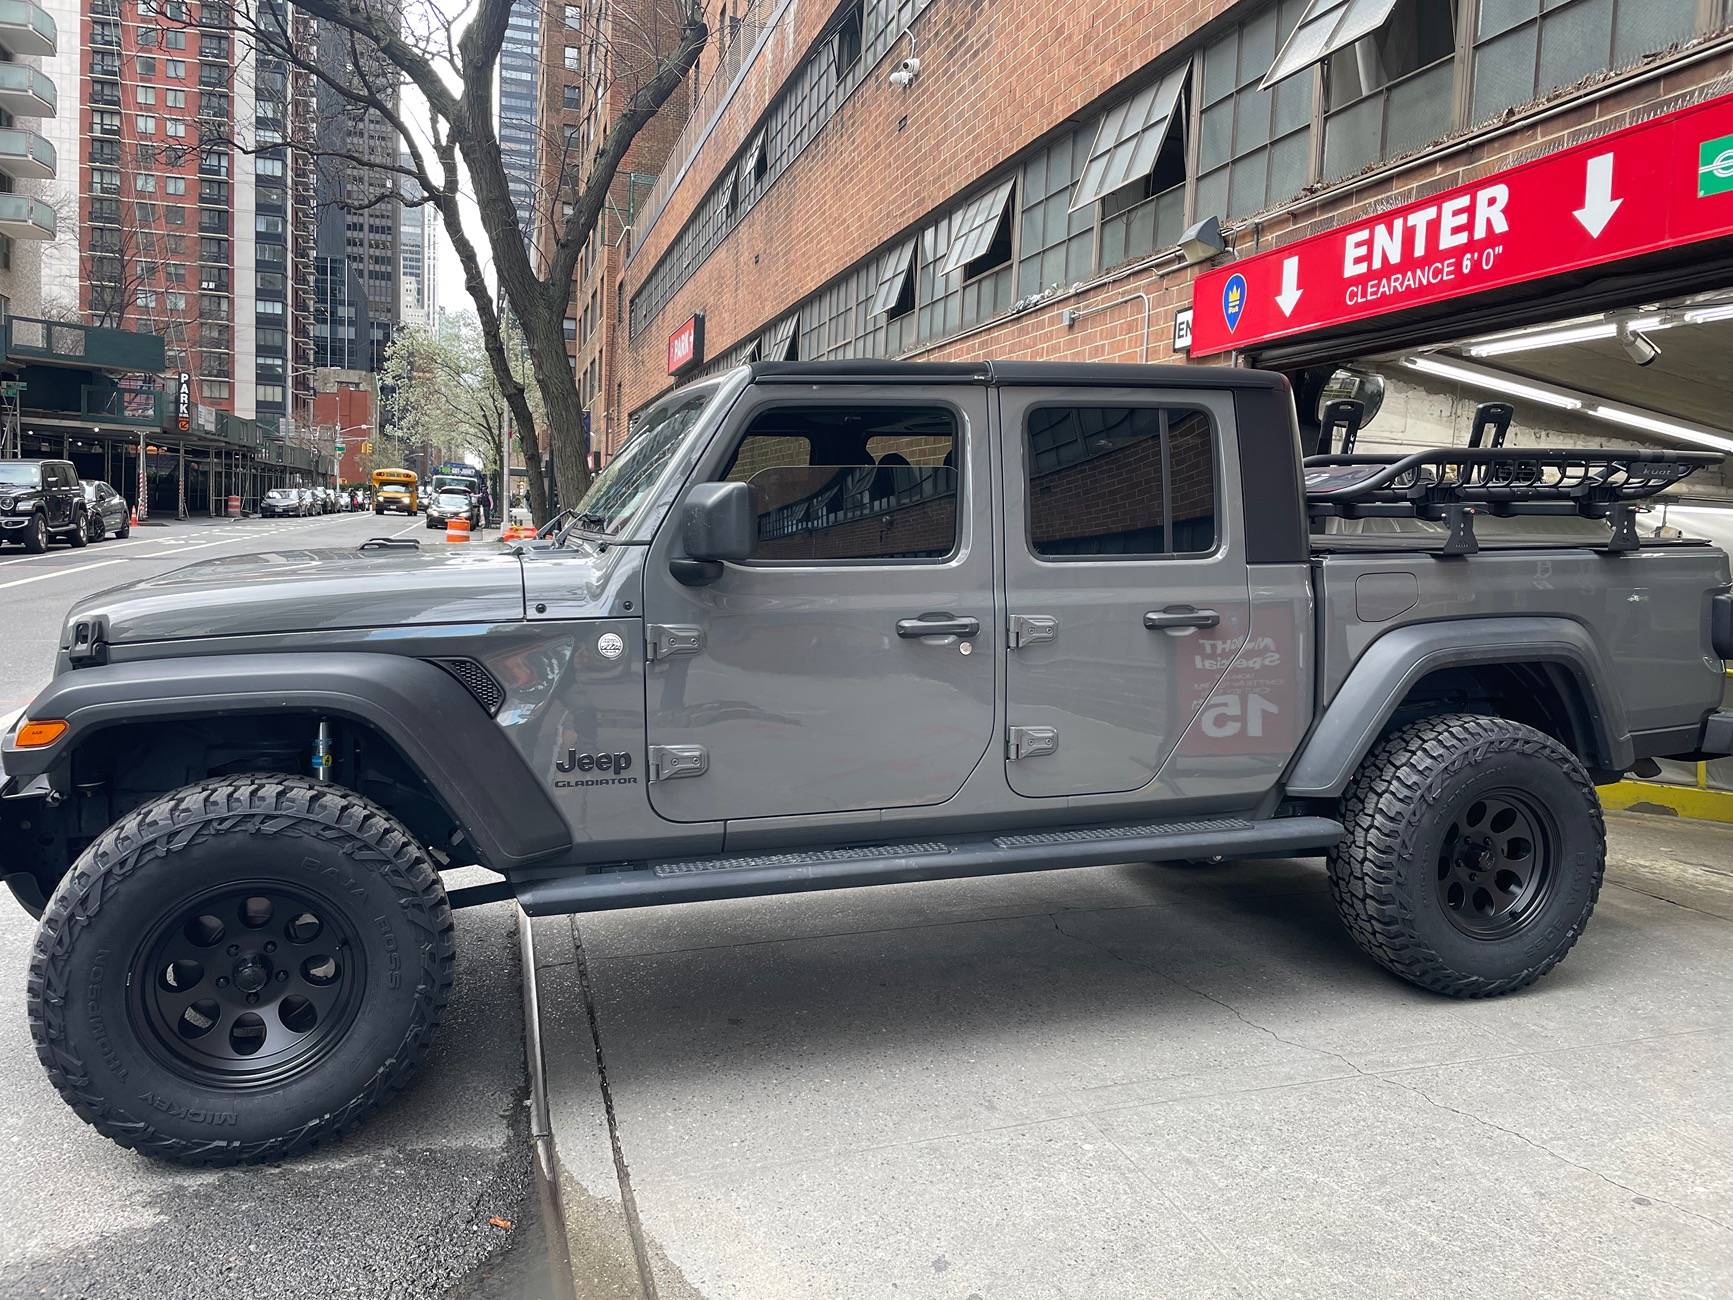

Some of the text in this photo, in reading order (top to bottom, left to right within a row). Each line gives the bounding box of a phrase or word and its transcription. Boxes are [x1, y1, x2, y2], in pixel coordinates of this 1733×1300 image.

[1343, 183, 1509, 278] ENTER
[1346, 258, 1456, 305] CLEARANCE
[180, 373, 189, 413] PARK
[556, 748, 632, 775] Jeep
[555, 777, 638, 788] GLADIATOR
